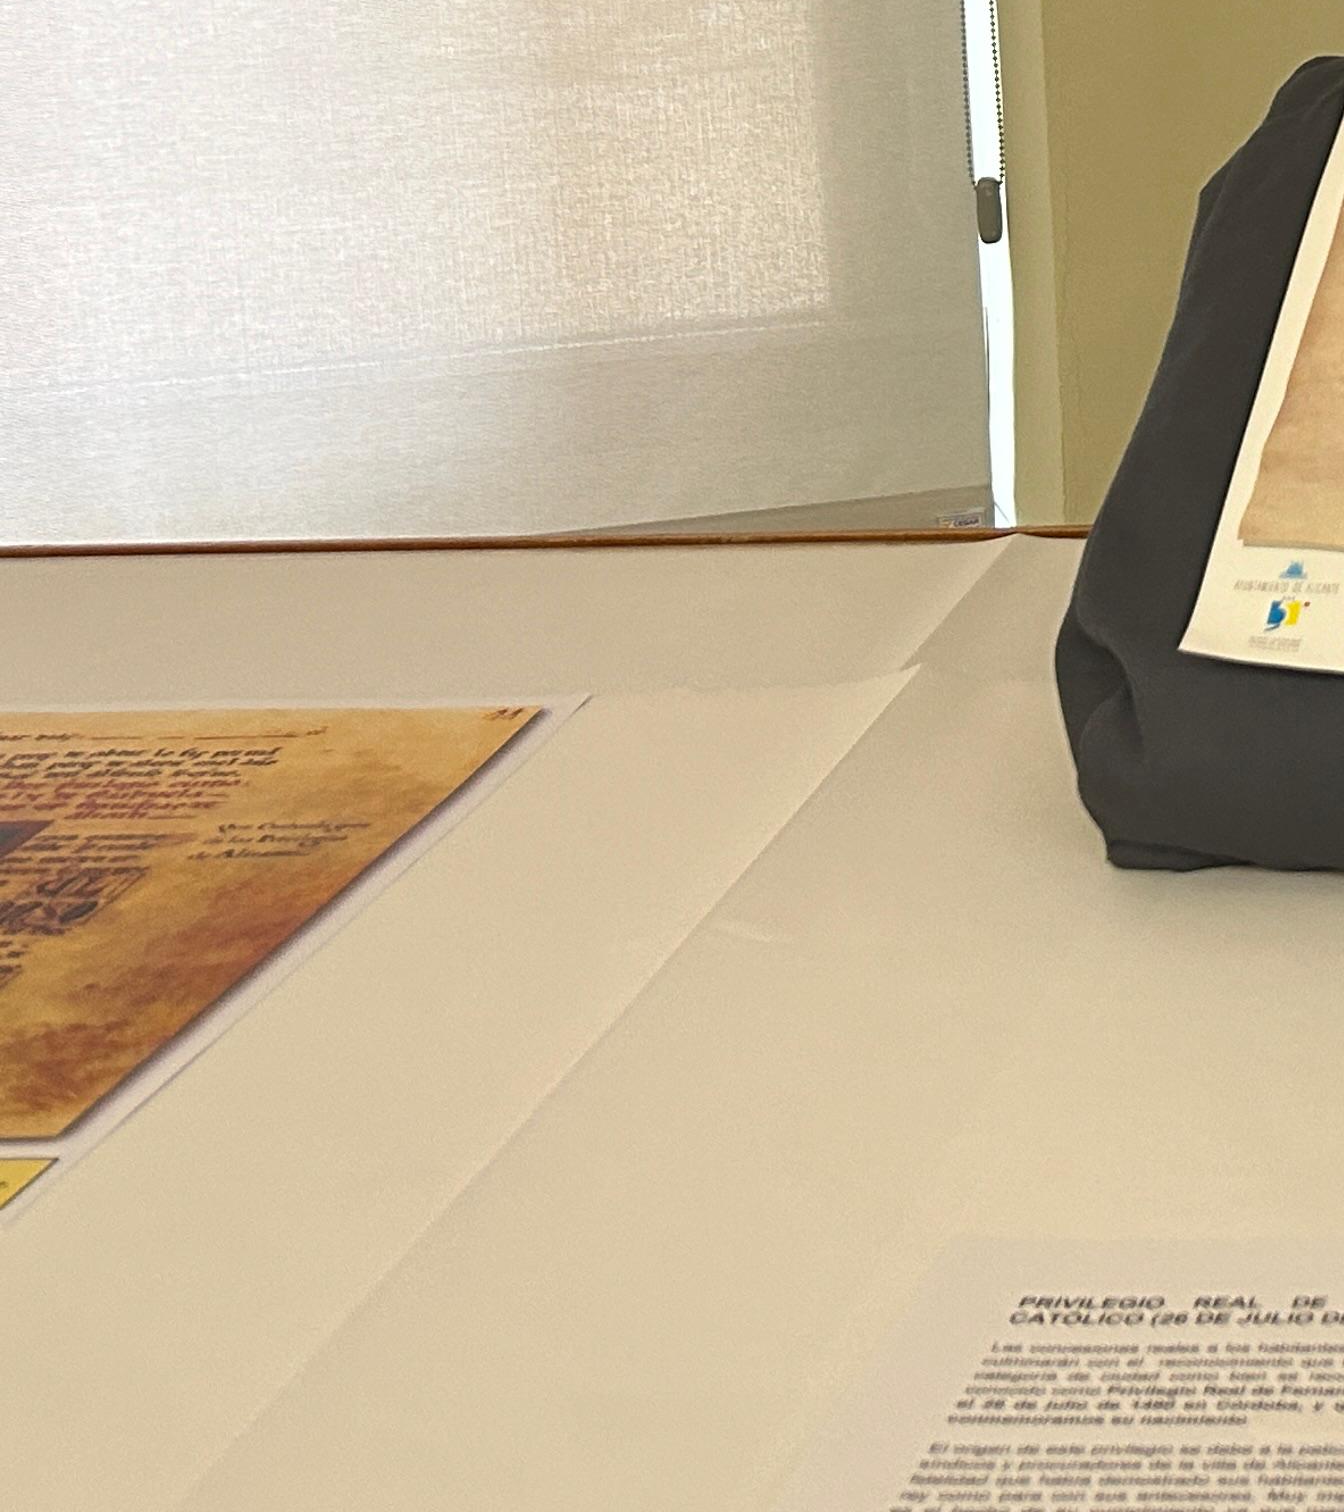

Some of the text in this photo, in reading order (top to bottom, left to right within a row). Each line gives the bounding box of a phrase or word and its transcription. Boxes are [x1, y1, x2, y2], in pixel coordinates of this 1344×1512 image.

[1018, 1296, 1165, 1312] PRIVILEGIO
[1193, 1296, 1258, 1311] REAL
[1291, 1296, 1326, 1309] DE
